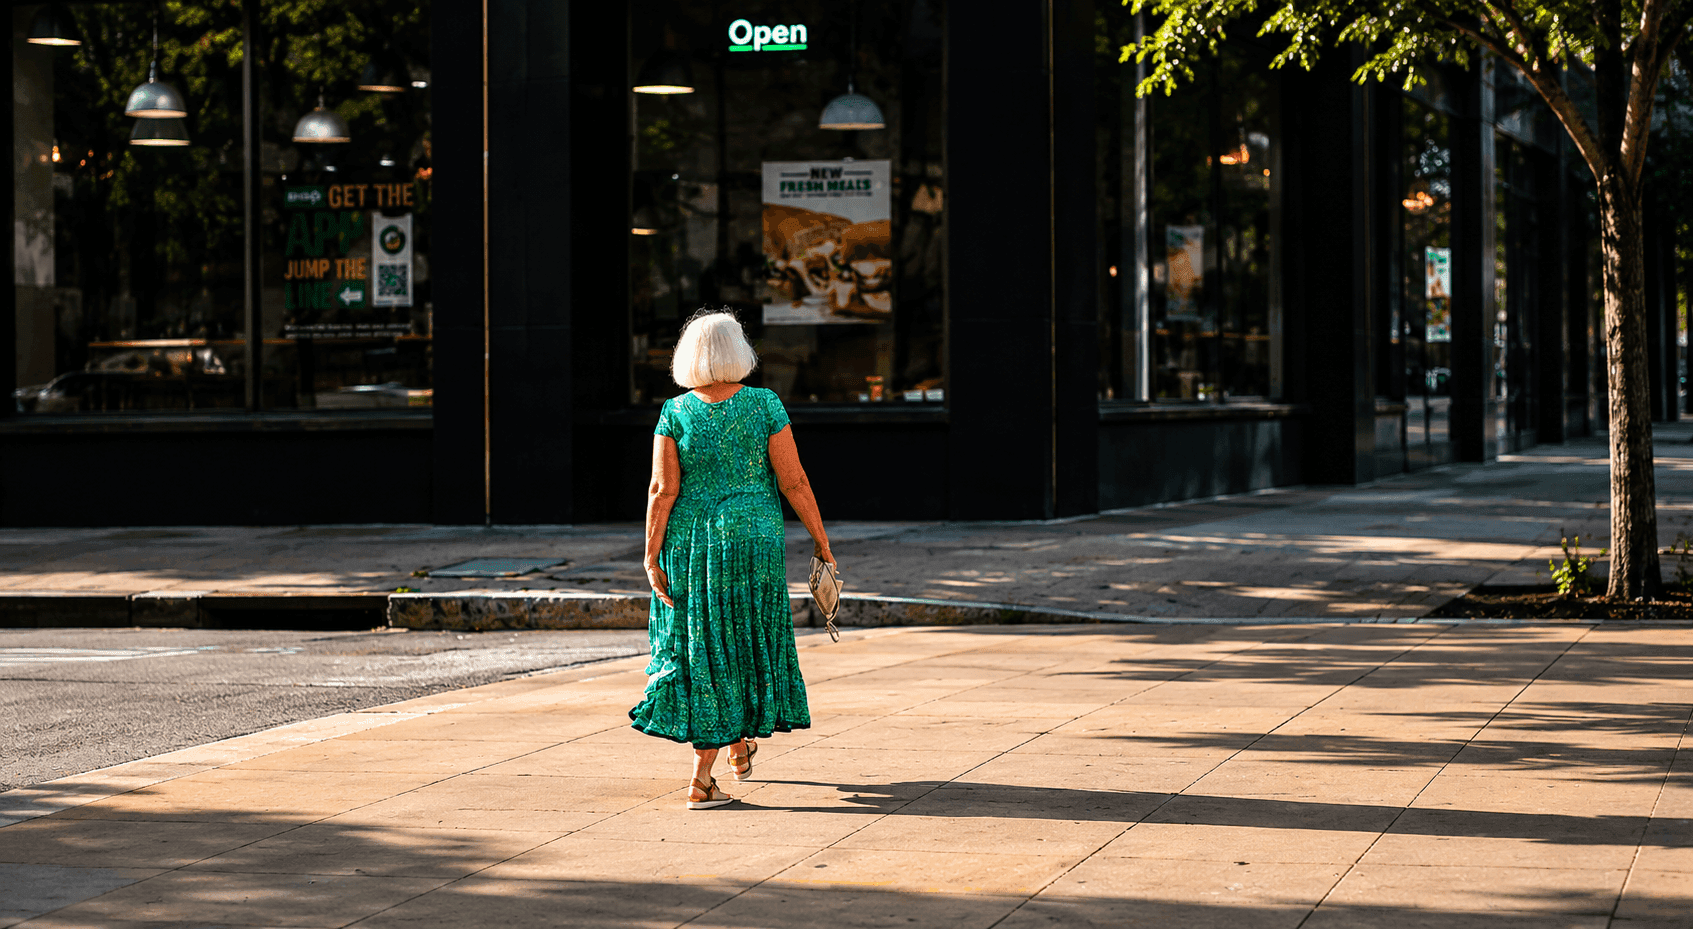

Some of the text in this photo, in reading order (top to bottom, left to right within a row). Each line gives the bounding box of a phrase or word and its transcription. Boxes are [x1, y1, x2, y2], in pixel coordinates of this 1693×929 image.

[728, 18, 807, 51] Open
[780, 180, 823, 192] FRESH
[810, 167, 843, 179] NEW
[328, 183, 368, 209] GET
[373, 182, 414, 207] THE
[285, 211, 364, 257] APP
[284, 258, 367, 280] JUMP THE
[284, 281, 332, 310] LINE
